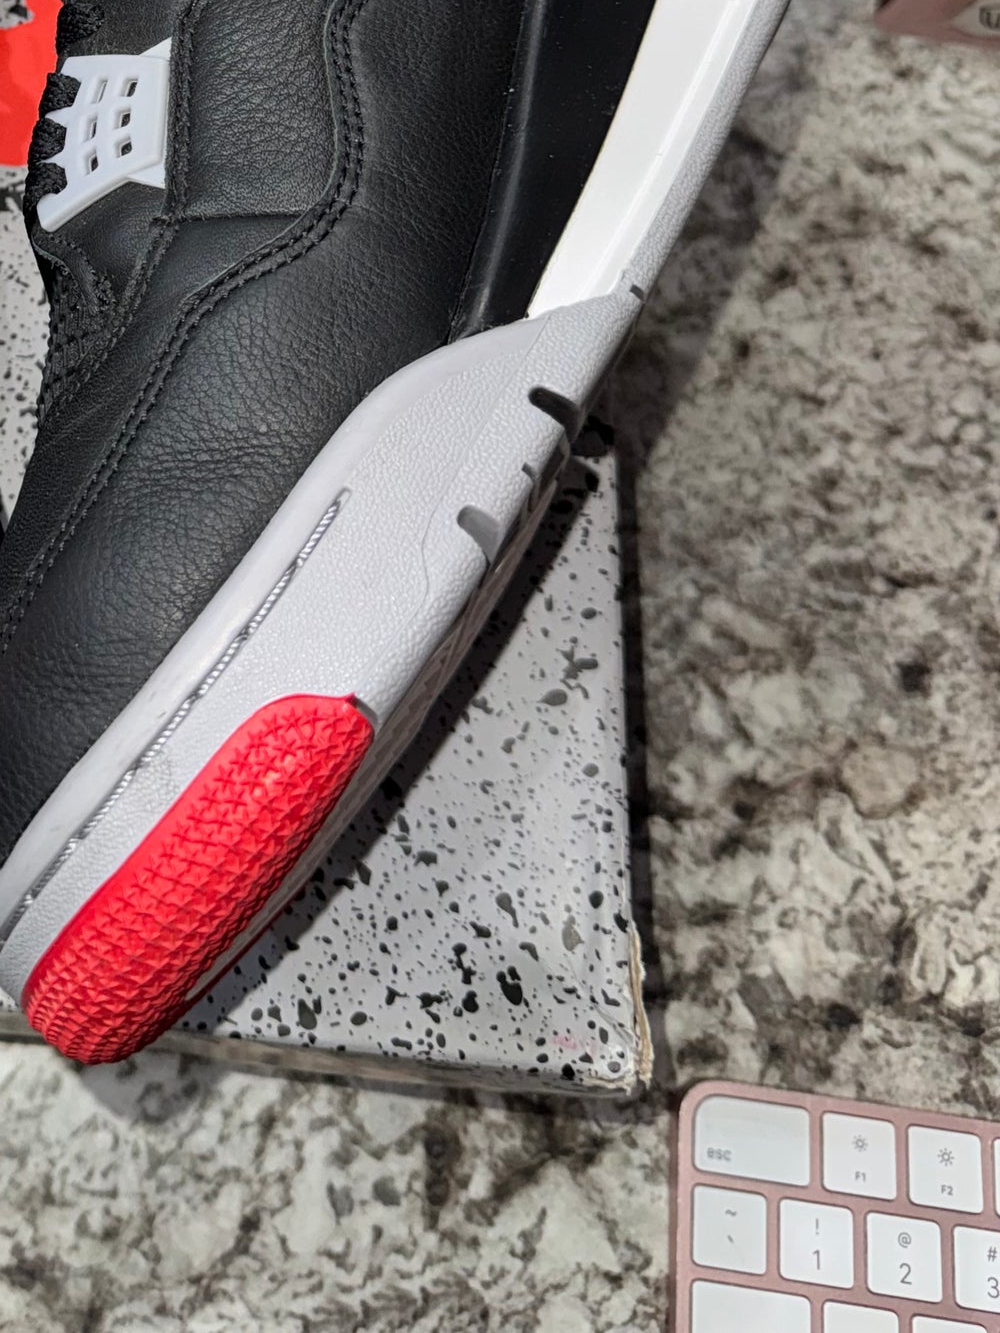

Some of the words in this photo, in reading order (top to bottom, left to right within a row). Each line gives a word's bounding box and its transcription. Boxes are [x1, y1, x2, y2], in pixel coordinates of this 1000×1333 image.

[706, 1147, 732, 1162] esc
[854, 1170, 867, 1183] F1
[940, 1184, 955, 1197] F2
[897, 1231, 912, 1249] @
[811, 1249, 821, 1271] 1
[986, 1246, 998, 1262] #
[899, 1262, 913, 1286] 2
[987, 1276, 1000, 1299] 3
